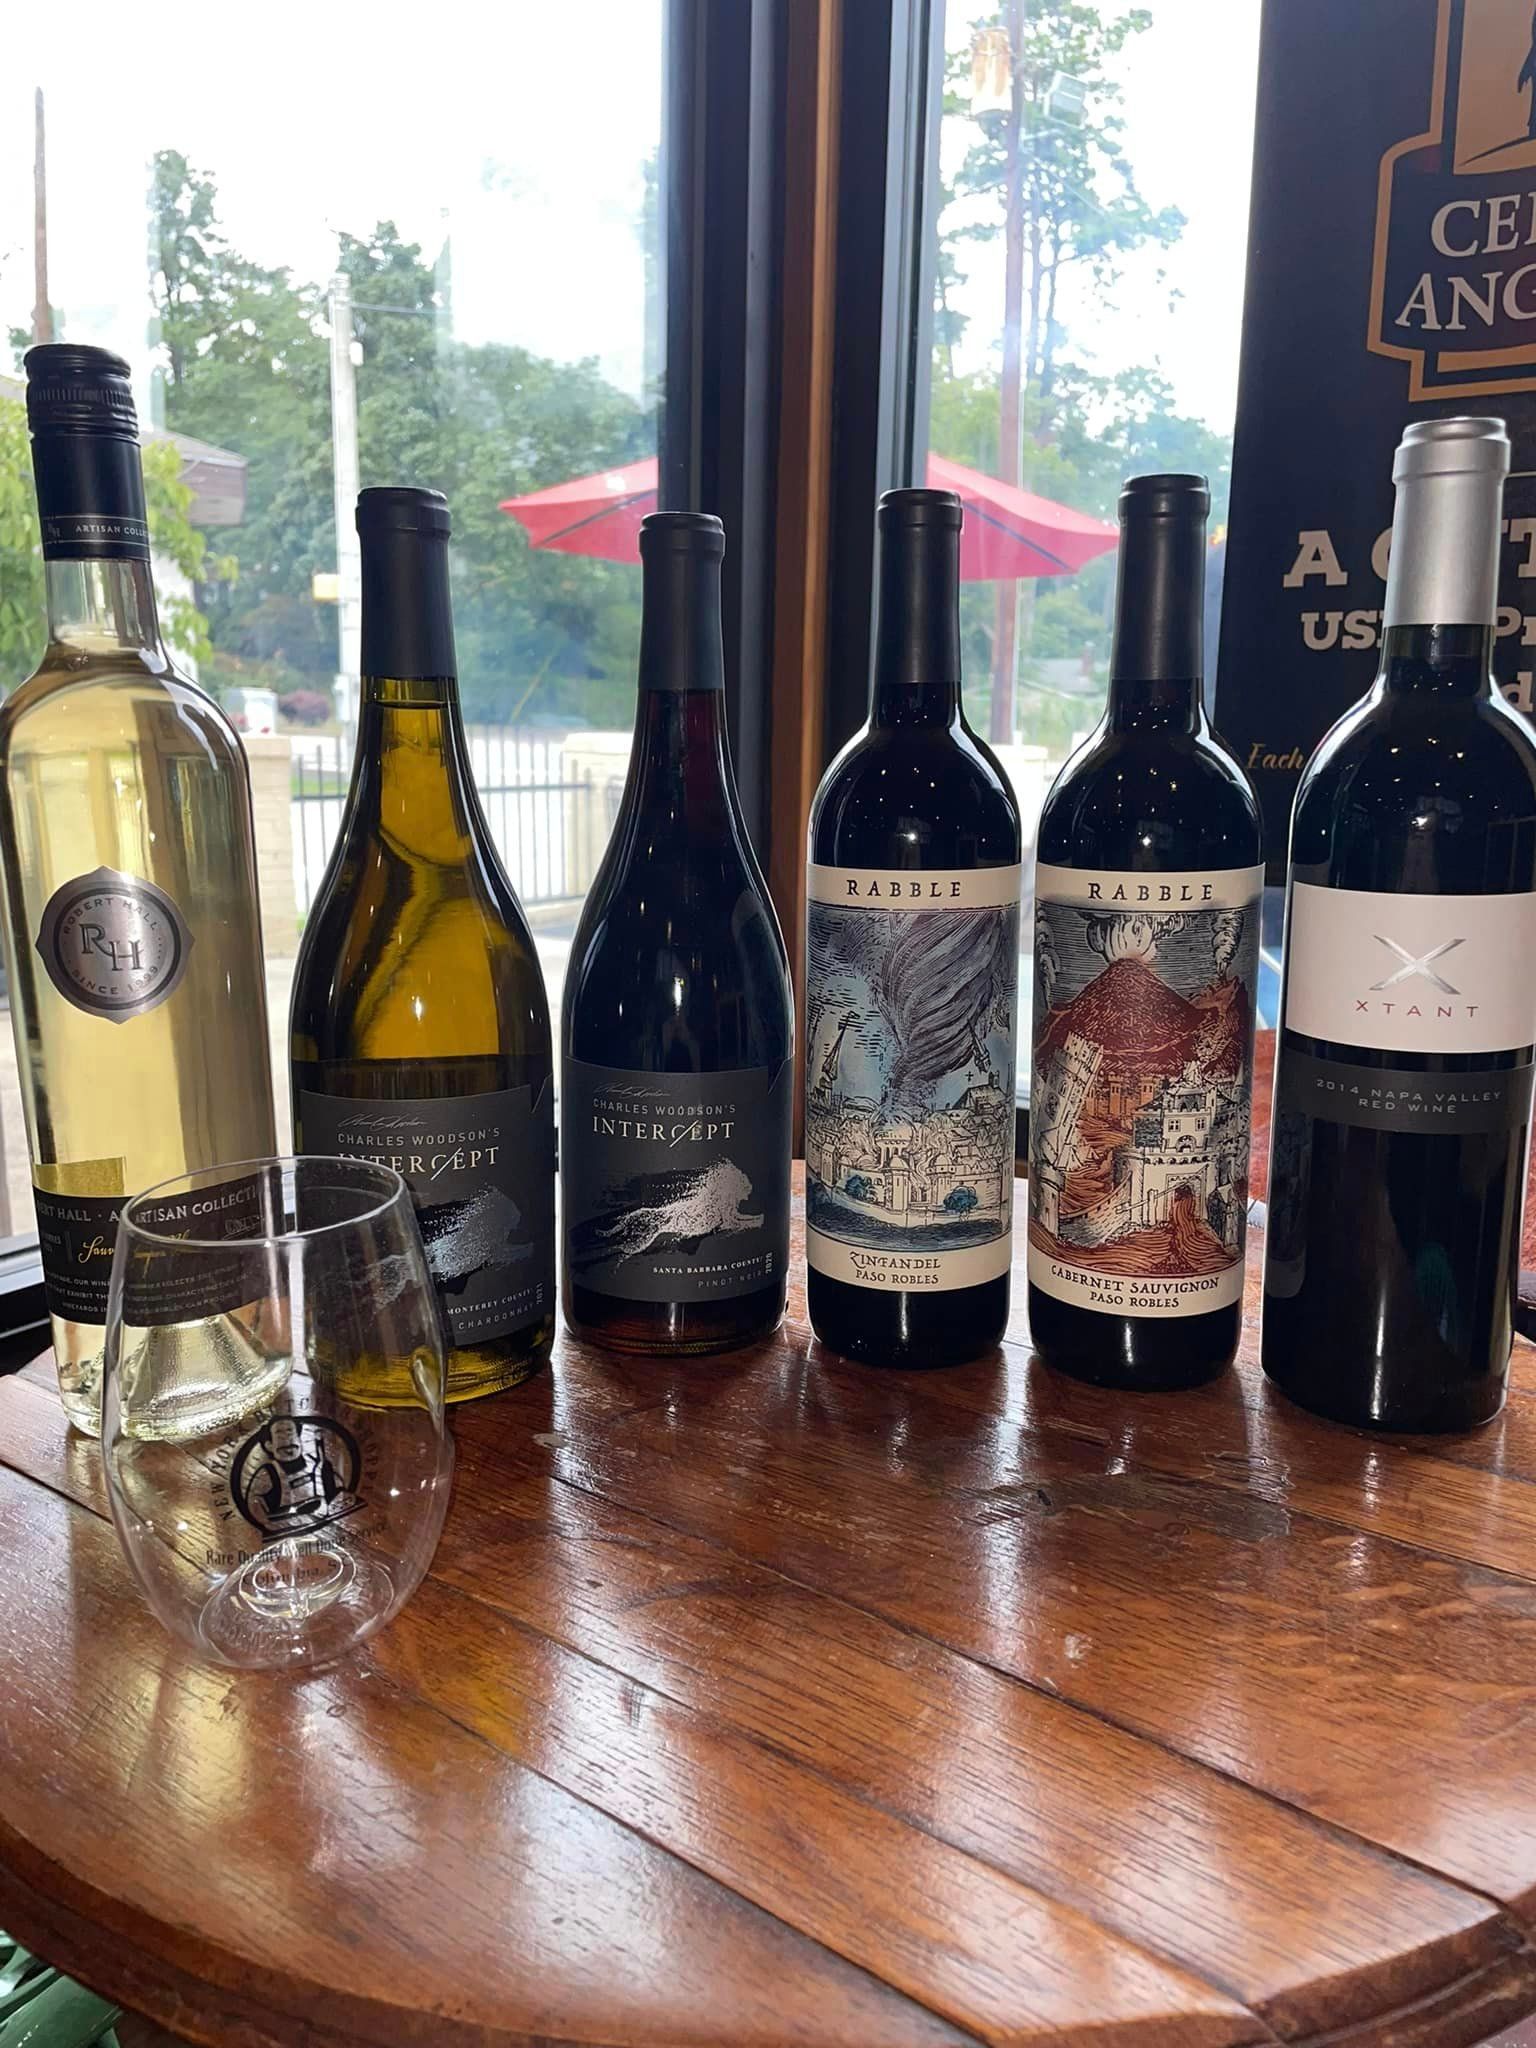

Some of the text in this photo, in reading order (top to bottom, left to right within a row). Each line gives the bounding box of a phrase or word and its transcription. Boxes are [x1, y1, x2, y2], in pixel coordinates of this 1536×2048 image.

[75, 524, 122, 535] ARTISAN
[1283, 529, 1348, 588] A
[846, 879, 962, 898] RABBLE
[1087, 882, 1214, 902] RABBLE
[63, 897, 157, 936] ROBERT HALL
[72, 969, 120, 996] SINCE
[1355, 999, 1479, 1018] XTANT
[1315, 1078, 1502, 1103] 2014 NAPA VALLEY
[593, 1097, 737, 1117] CHARLES WOODSON'S
[1358, 1098, 1457, 1114] RED WINE
[336, 1126, 501, 1147] CHARLES WOODSON'S
[592, 1115, 735, 1149] INTERCEPT
[57, 1206, 91, 1223] HALL
[652, 1265, 684, 1275] SANTA
[686, 1262, 729, 1274] BARBARA
[849, 1250, 942, 1271] ZINFANDEL
[855, 1270, 939, 1286] PASO ROBLES
[1050, 1264, 1220, 1295] CABERNET SAUVIGNON
[1090, 1291, 1180, 1309] PASO ROBLES
[458, 1301, 535, 1330] CHARDONNAY
[206, 1550, 234, 1566] Rare
